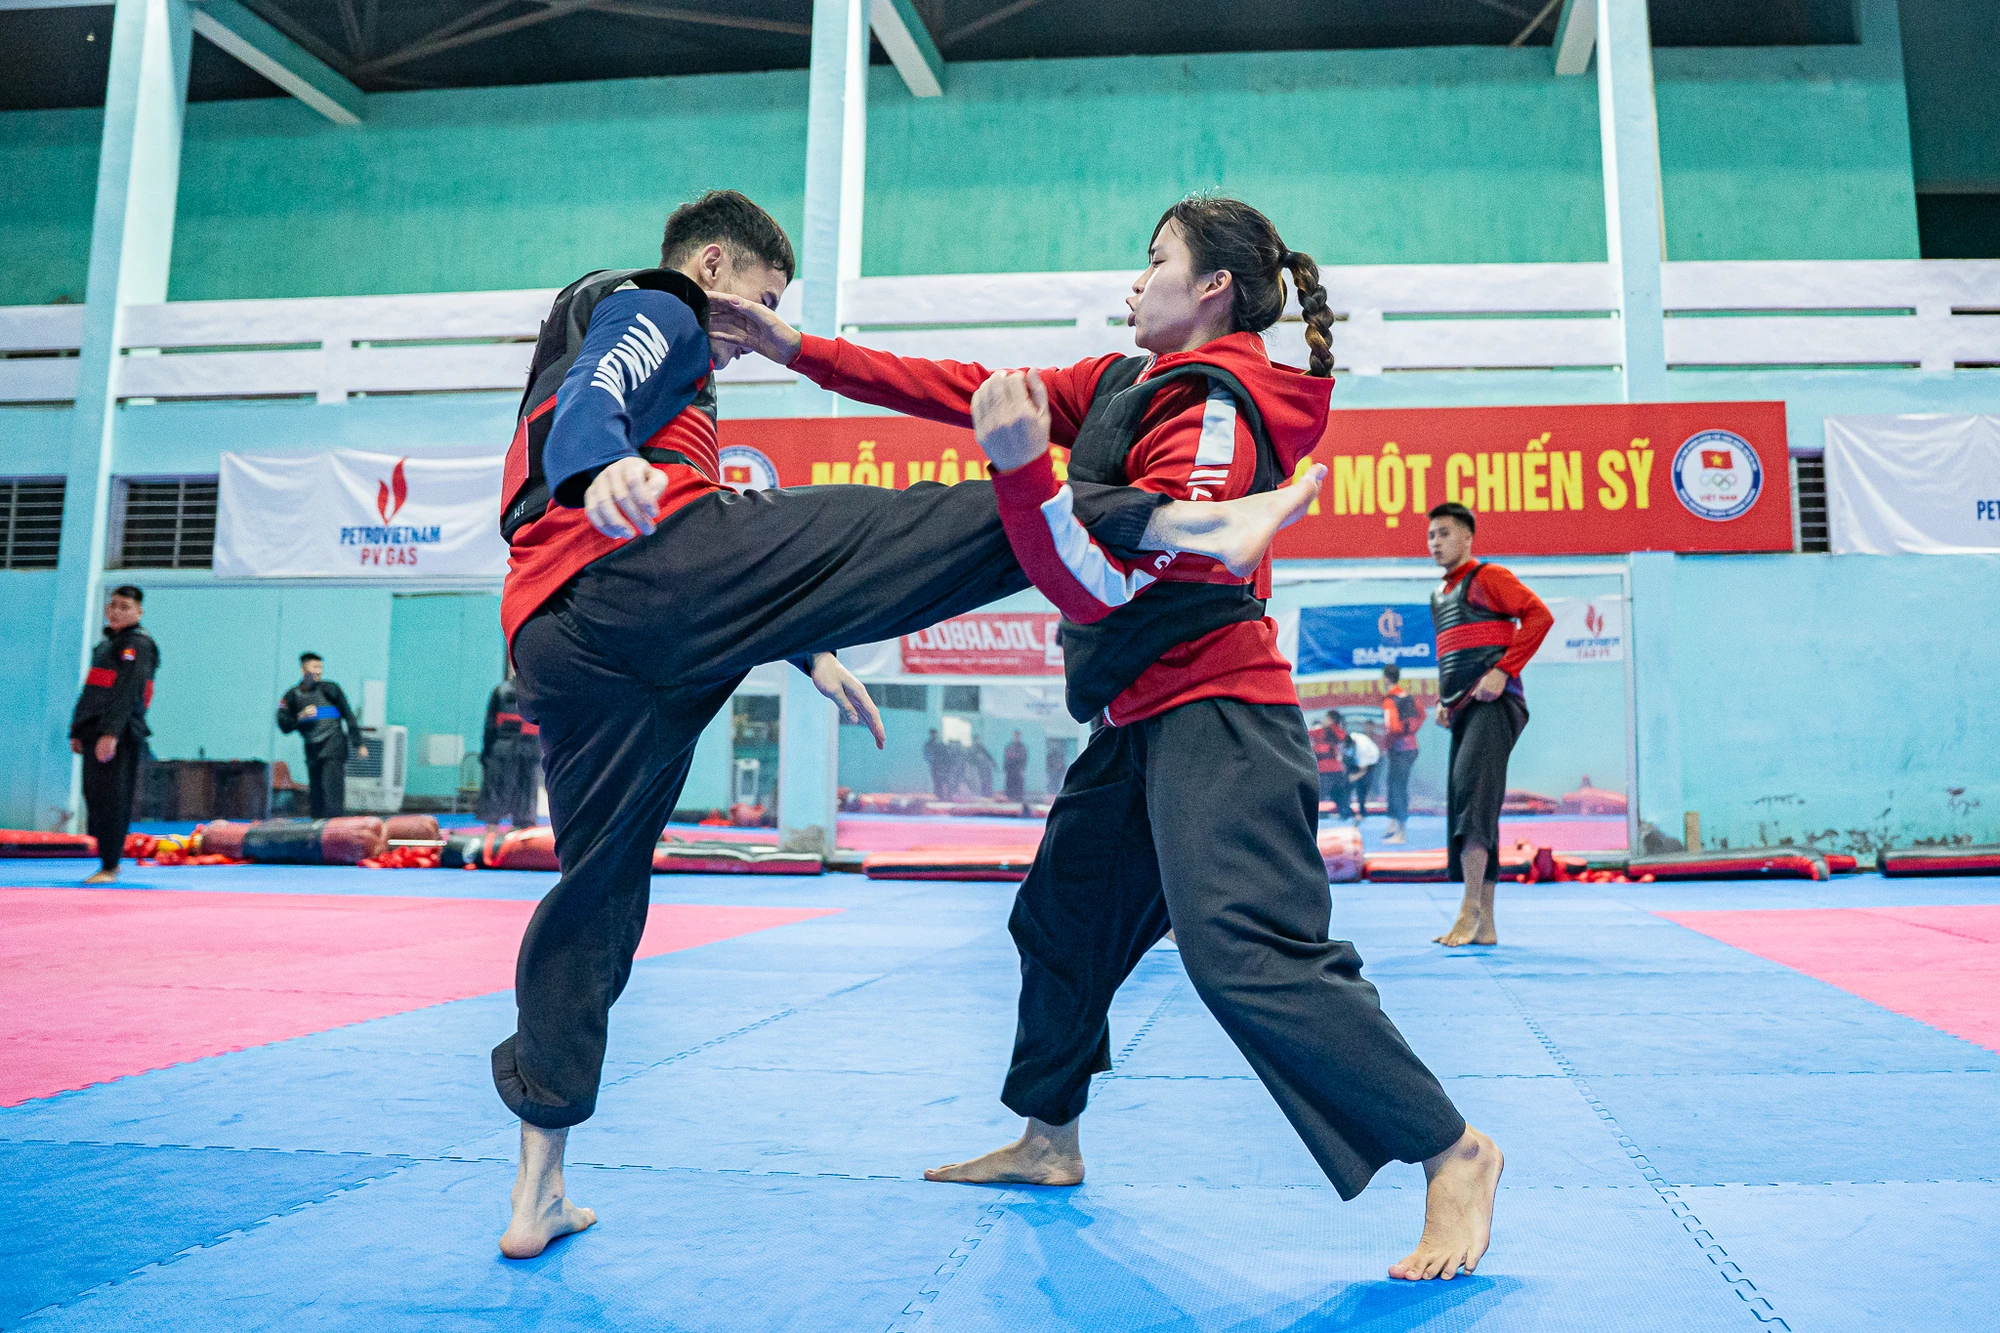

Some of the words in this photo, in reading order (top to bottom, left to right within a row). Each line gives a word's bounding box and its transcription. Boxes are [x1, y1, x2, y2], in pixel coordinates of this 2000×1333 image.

[1333, 441, 1432, 528] MỘT
[1445, 432, 1584, 512] CHIẾN
[1597, 437, 1655, 511] SỸ
[340, 527, 441, 545] PETROVIETNAM
[361, 547, 382, 566] PV
[386, 547, 418, 566] GAS
